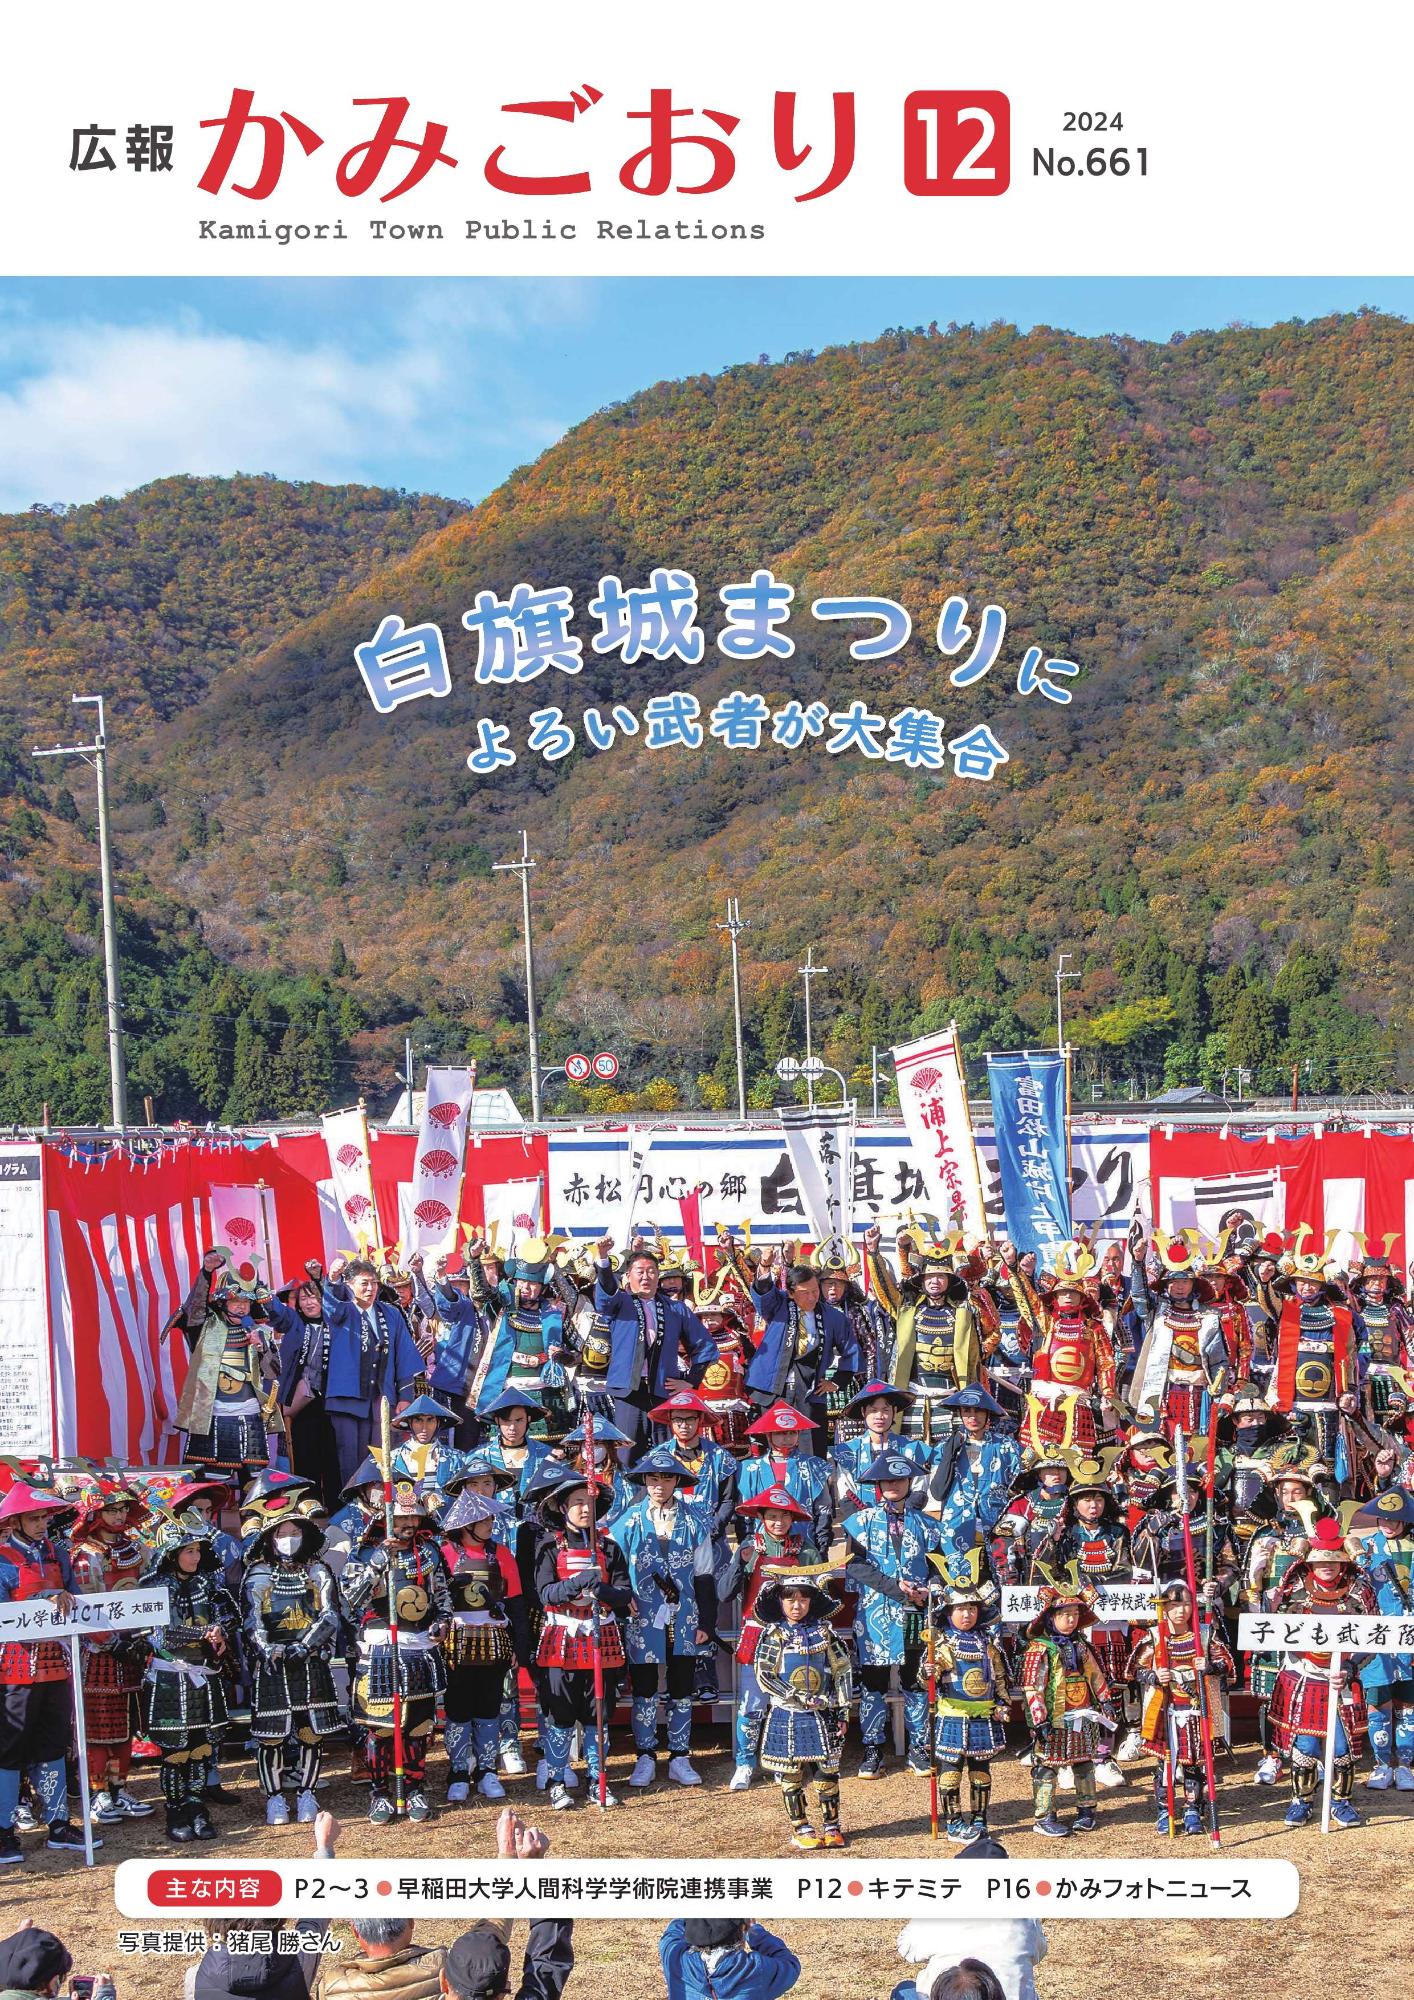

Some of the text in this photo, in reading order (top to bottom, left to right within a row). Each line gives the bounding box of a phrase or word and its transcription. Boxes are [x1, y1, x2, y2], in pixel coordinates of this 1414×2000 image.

[598, 1060, 613, 1072] 50
[0, 1600, 164, 1629] ール学園ICT隊 大阪市
